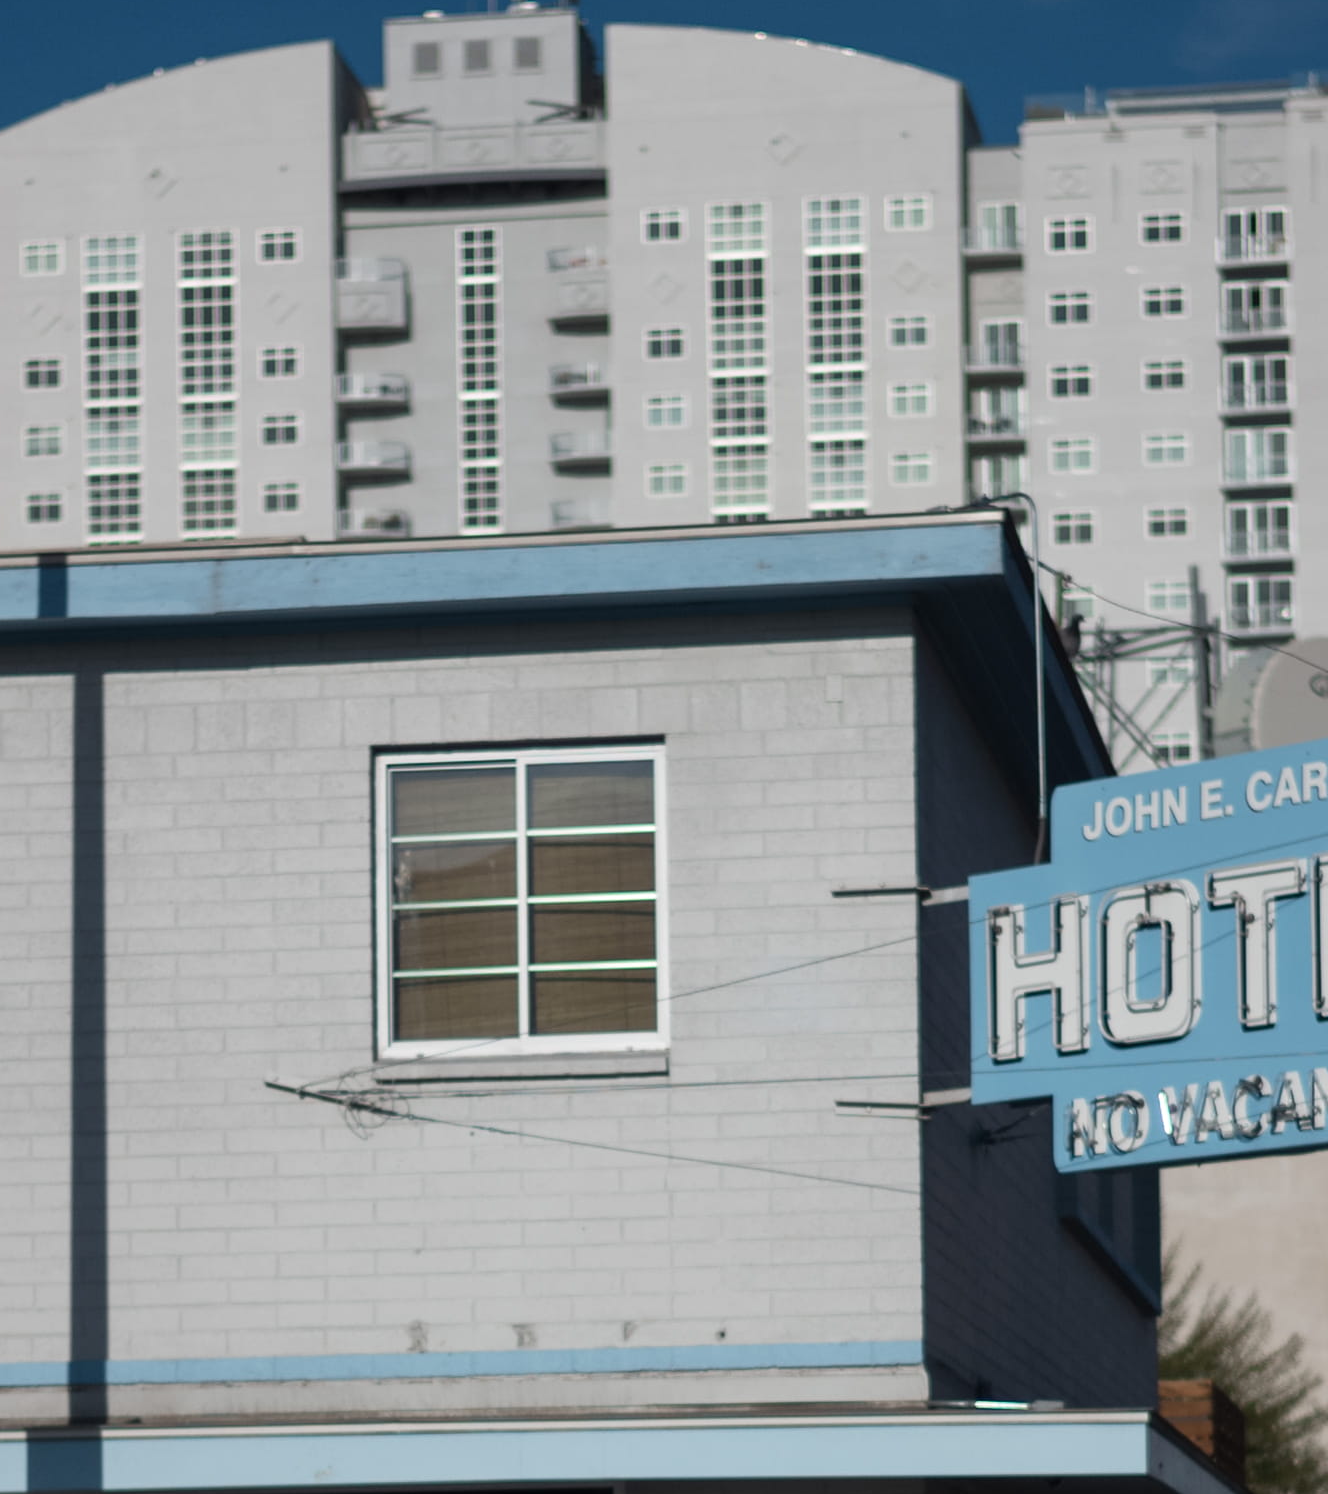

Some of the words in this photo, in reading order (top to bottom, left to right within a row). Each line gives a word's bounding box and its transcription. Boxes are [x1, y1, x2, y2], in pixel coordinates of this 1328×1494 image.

[1083, 786, 1187, 841] JOHN
[1200, 779, 1234, 820] E.
[1070, 1091, 1147, 1159] NO
